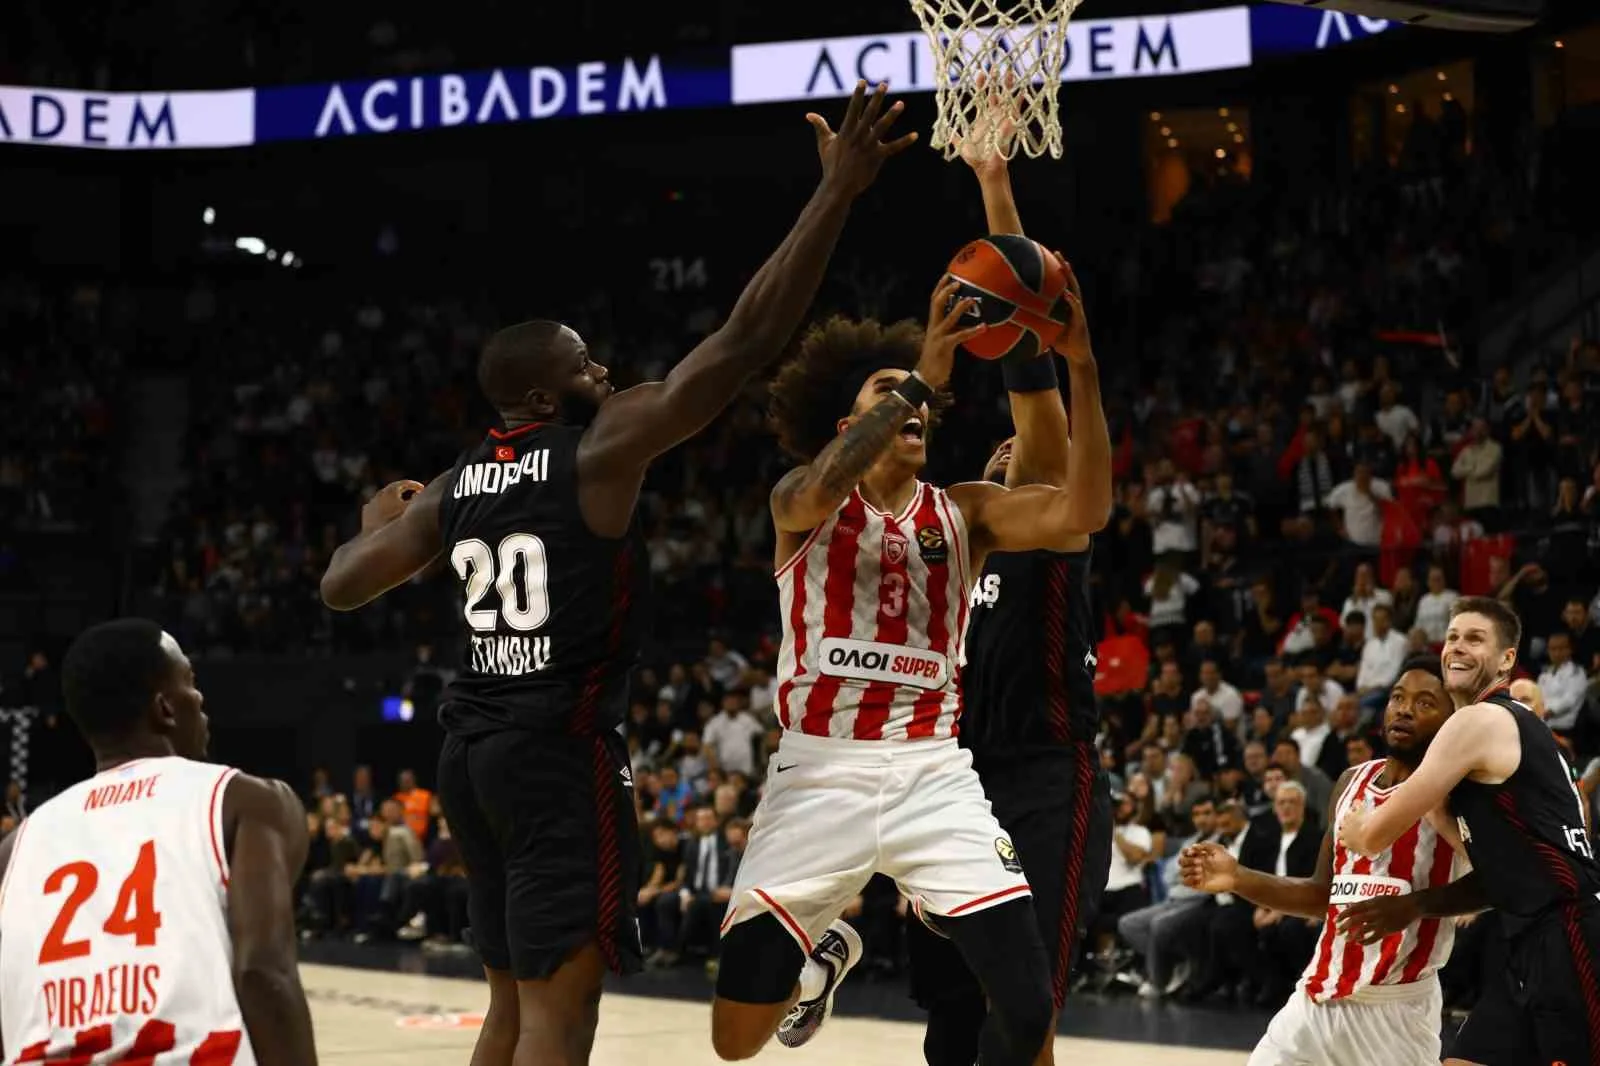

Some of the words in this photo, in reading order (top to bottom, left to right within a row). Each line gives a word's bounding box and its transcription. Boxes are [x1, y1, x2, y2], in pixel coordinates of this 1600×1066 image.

[315, 54, 667, 137] ACIBADEM
[451, 533, 551, 632] 20
[881, 573, 906, 618] 3
[892, 655, 940, 679] SUPER
[84, 774, 161, 812] NDIAYE
[38, 839, 162, 966] 24
[43, 963, 160, 1028] PIRAEUS
